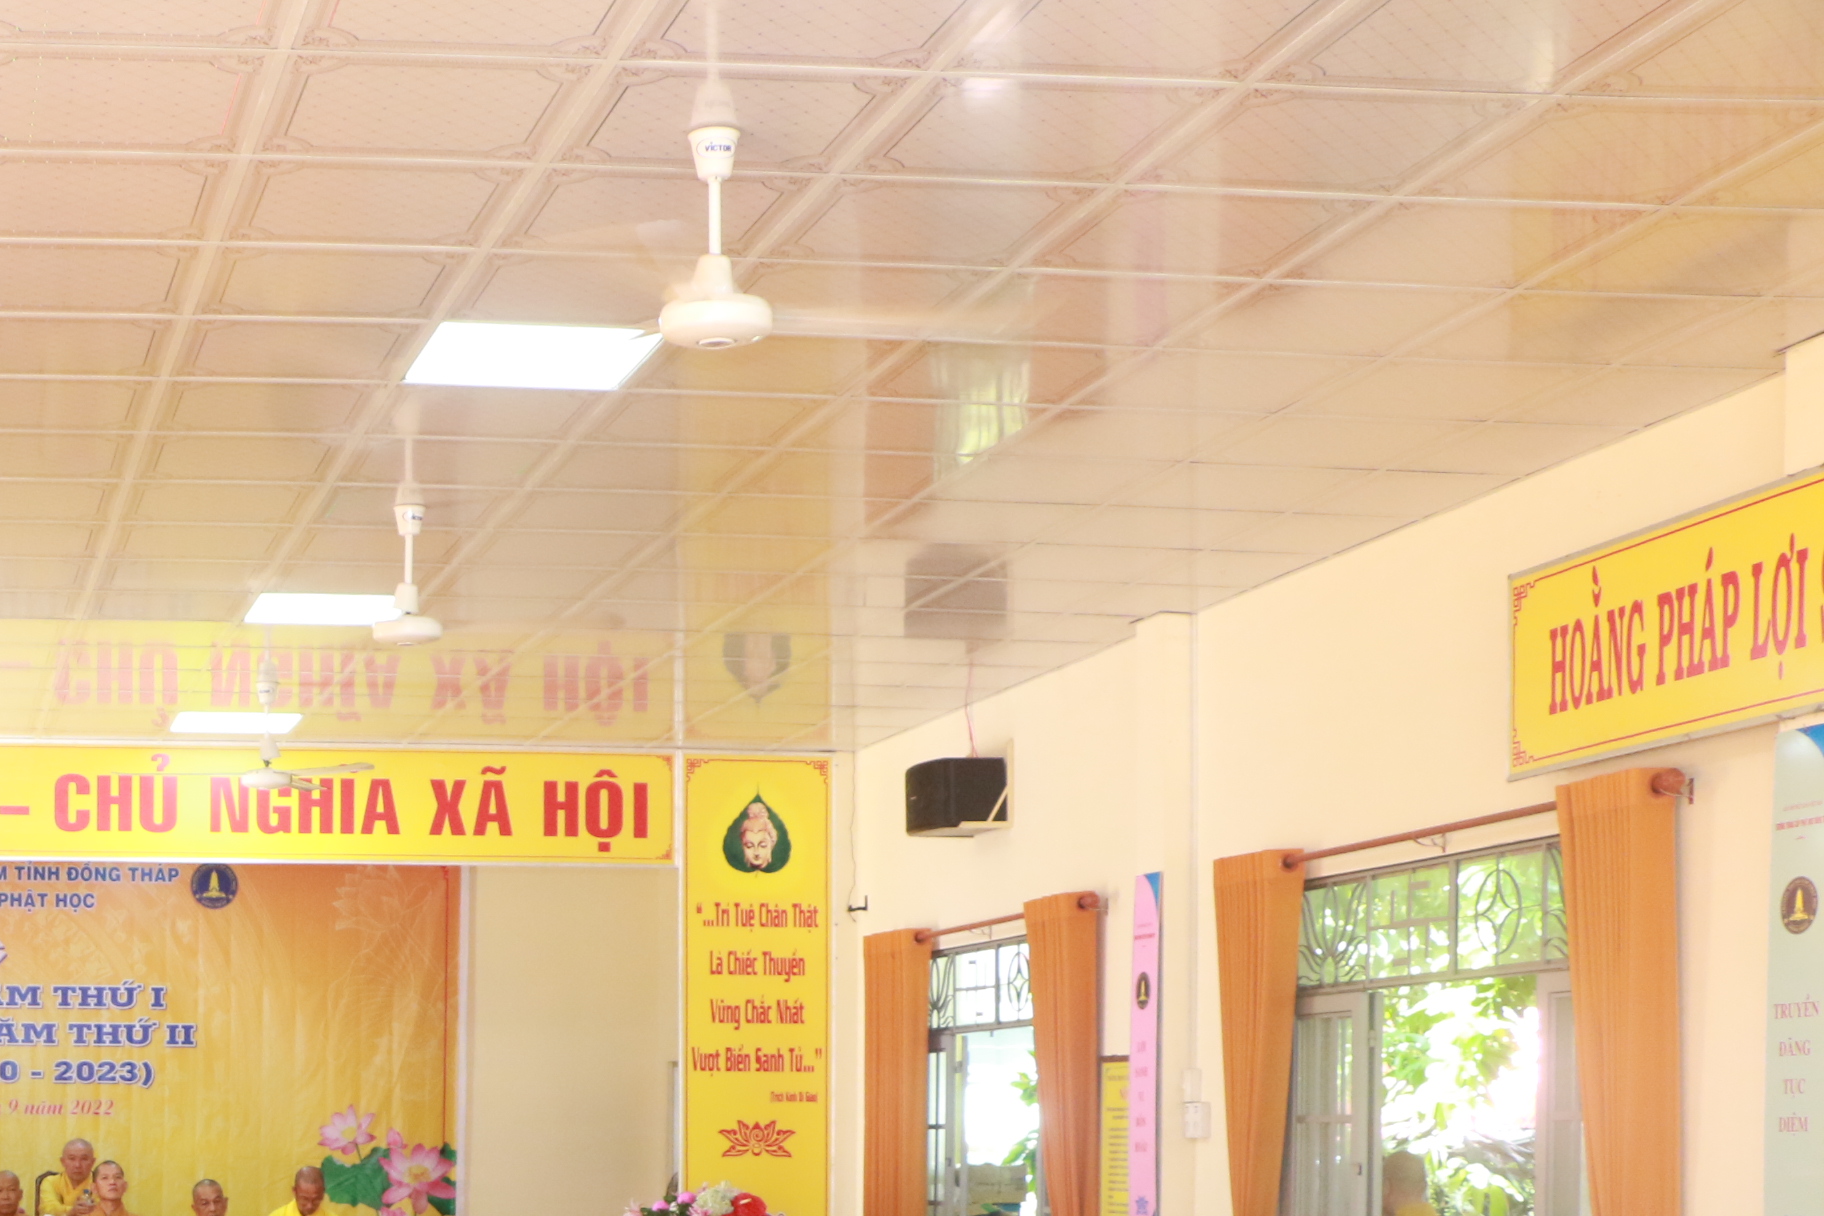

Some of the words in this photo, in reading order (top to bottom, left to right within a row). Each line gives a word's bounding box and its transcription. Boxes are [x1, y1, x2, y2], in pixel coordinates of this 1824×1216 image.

[1549, 565, 1646, 716] HOẰNG
[1656, 547, 1740, 686] PHÁP
[1750, 533, 1808, 680] LỢI
[54, 754, 177, 833] CHỦ
[429, 766, 512, 836] XÃ
[543, 769, 648, 852] HỘI
[12, 862, 61, 882] TỈNH
[66, 860, 122, 883] ĐỒNG
[127, 864, 180, 884] THÁP
[55, 893, 96, 912] HỌC
[734, 903, 755, 933] Tuệ
[759, 903, 788, 928] Chân
[792, 903, 819, 934] Thật
[710, 950, 723, 976] Là
[727, 948, 758, 976] Chiếc
[762, 948, 805, 983] Thuyền
[52, 979, 144, 1010] THỨ
[148, 984, 168, 1010] I
[710, 998, 741, 1030] Vững
[744, 995, 772, 1024] Chắc
[777, 995, 805, 1024] Nhất
[67, 1016, 158, 1047] THỨ
[164, 1022, 197, 1047] II
[725, 1044, 751, 1072] Biển
[755, 1048, 784, 1072] Sanh
[52, 1059, 155, 1089] 2023)
[8, 1099, 20, 1115] 9
[24, 1099, 66, 1117] năm
[70, 1099, 115, 1117] 2022
